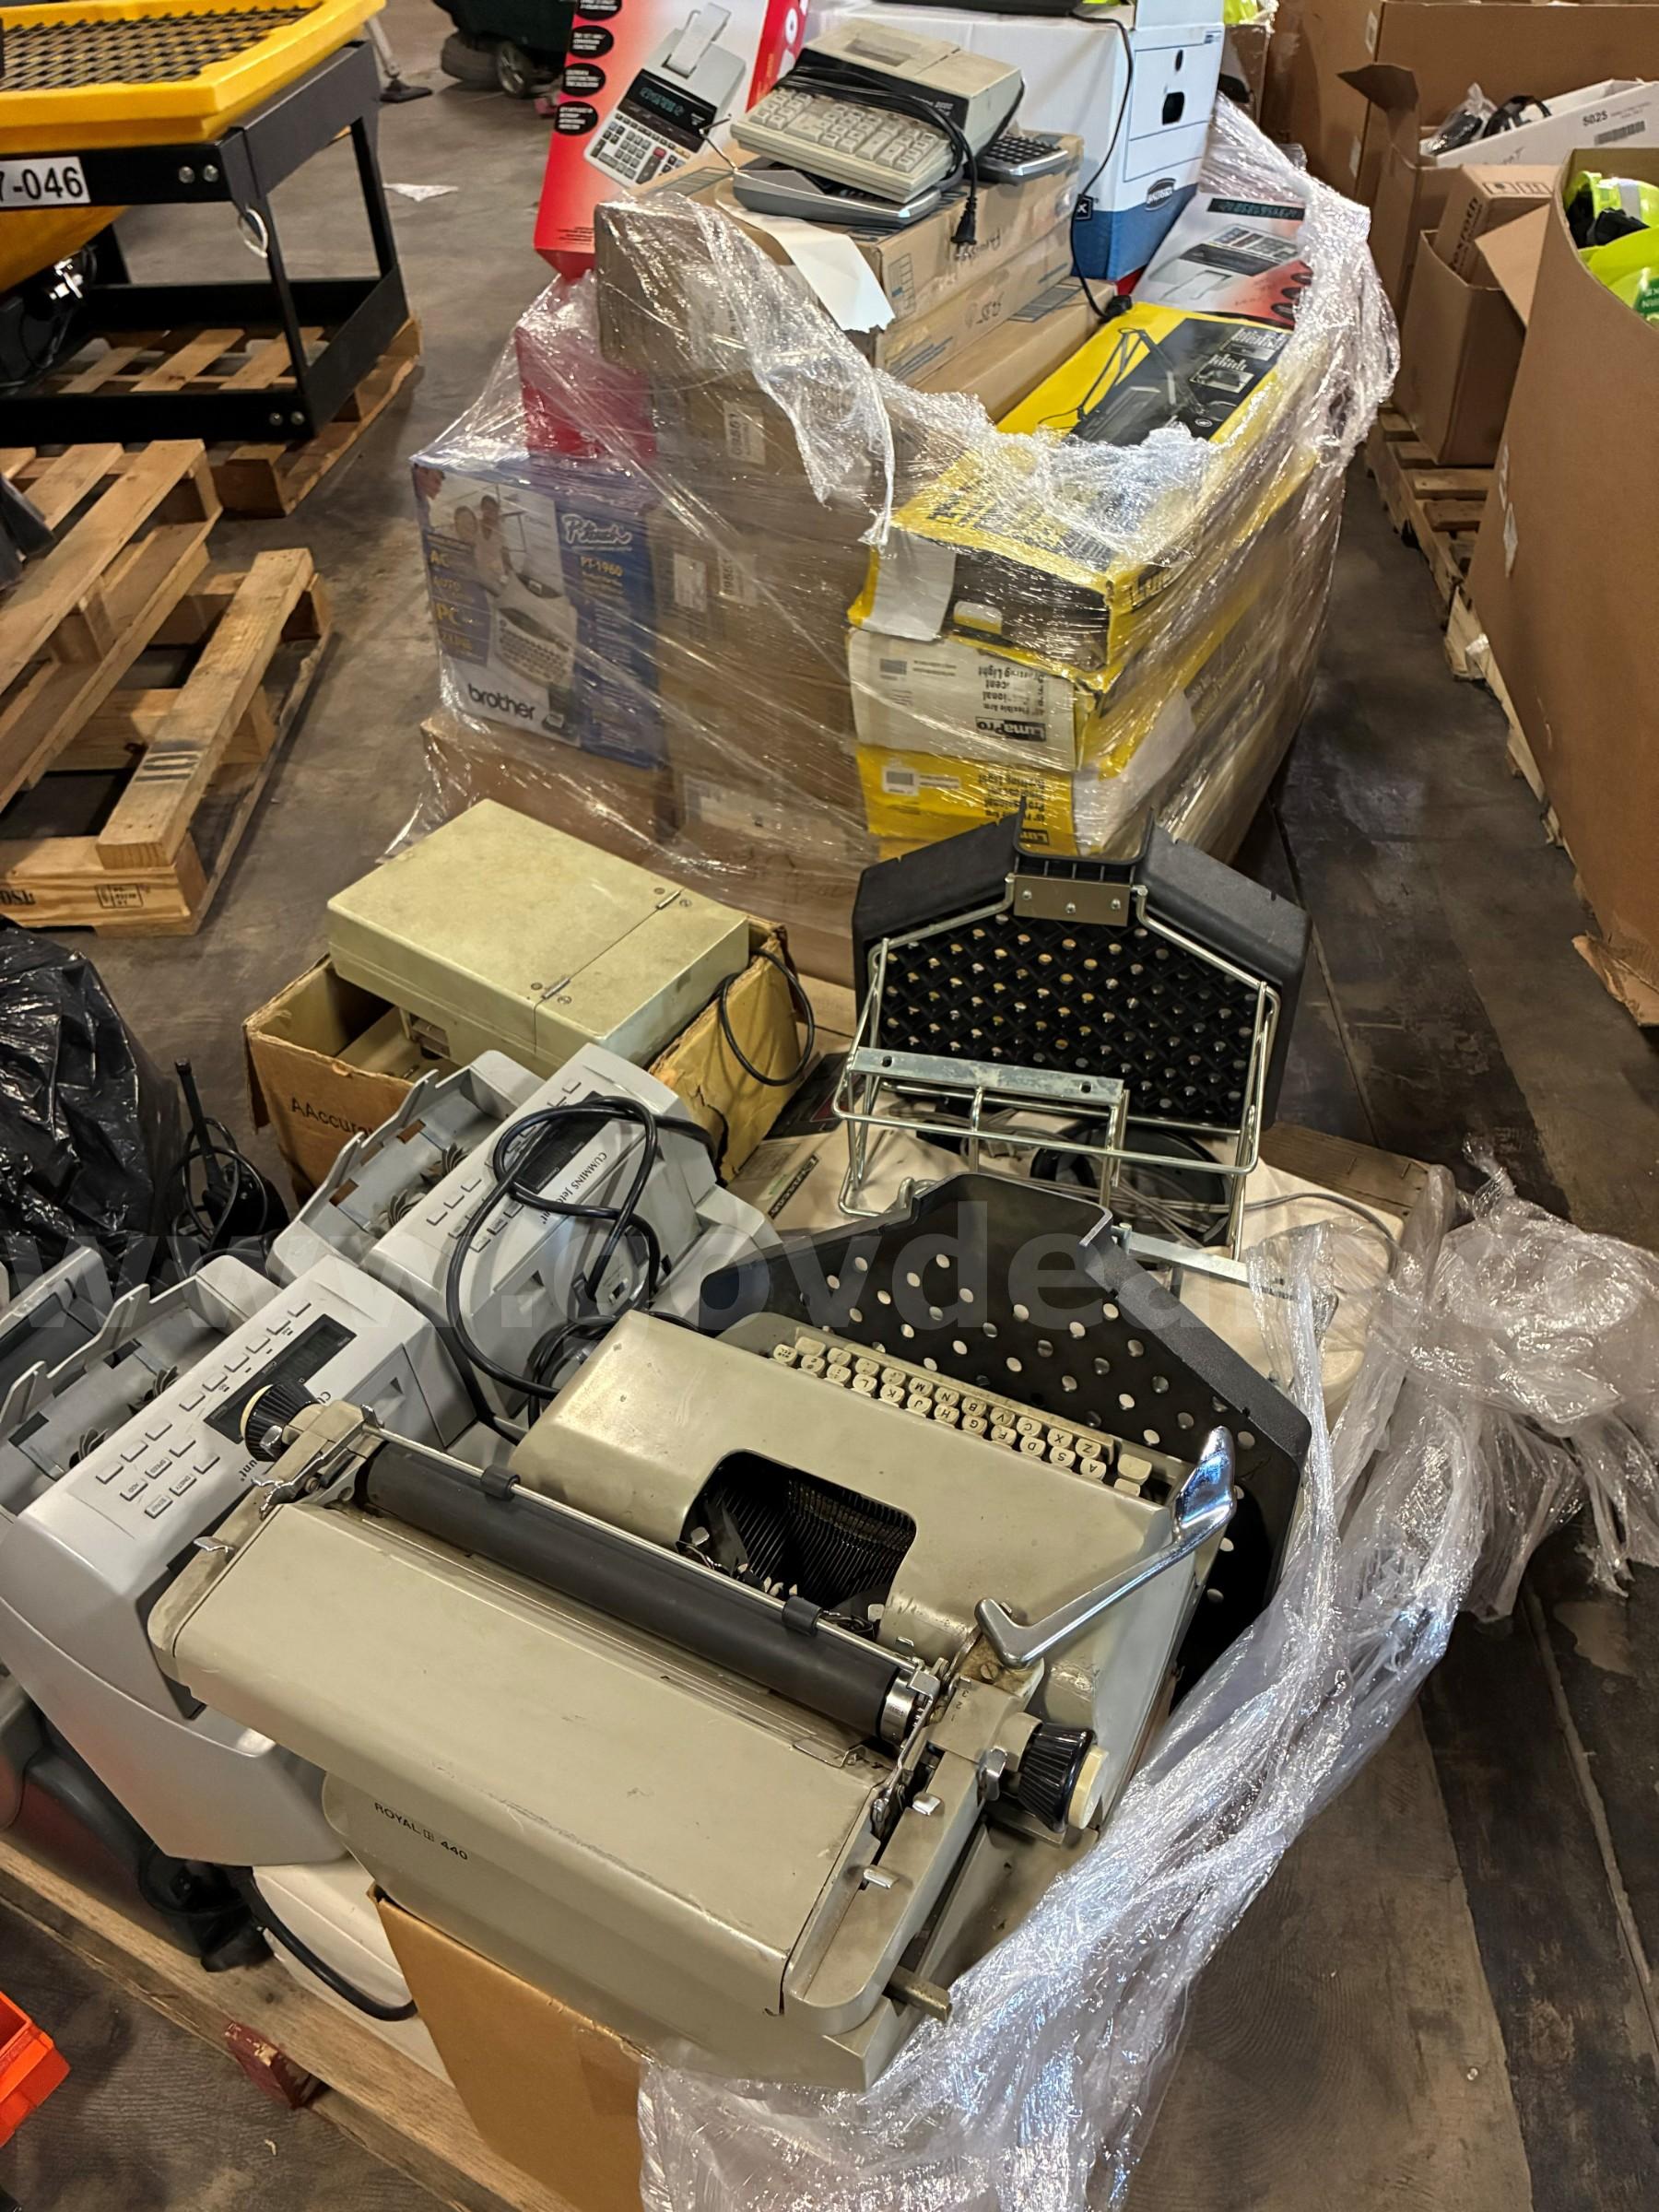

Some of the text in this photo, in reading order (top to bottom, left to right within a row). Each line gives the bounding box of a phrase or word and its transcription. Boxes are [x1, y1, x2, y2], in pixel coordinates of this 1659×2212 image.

[467, 683, 537, 722] brother
[571, 1152, 607, 1190] CUMMINS
[374, 1802, 468, 1861] ROYAL 440
